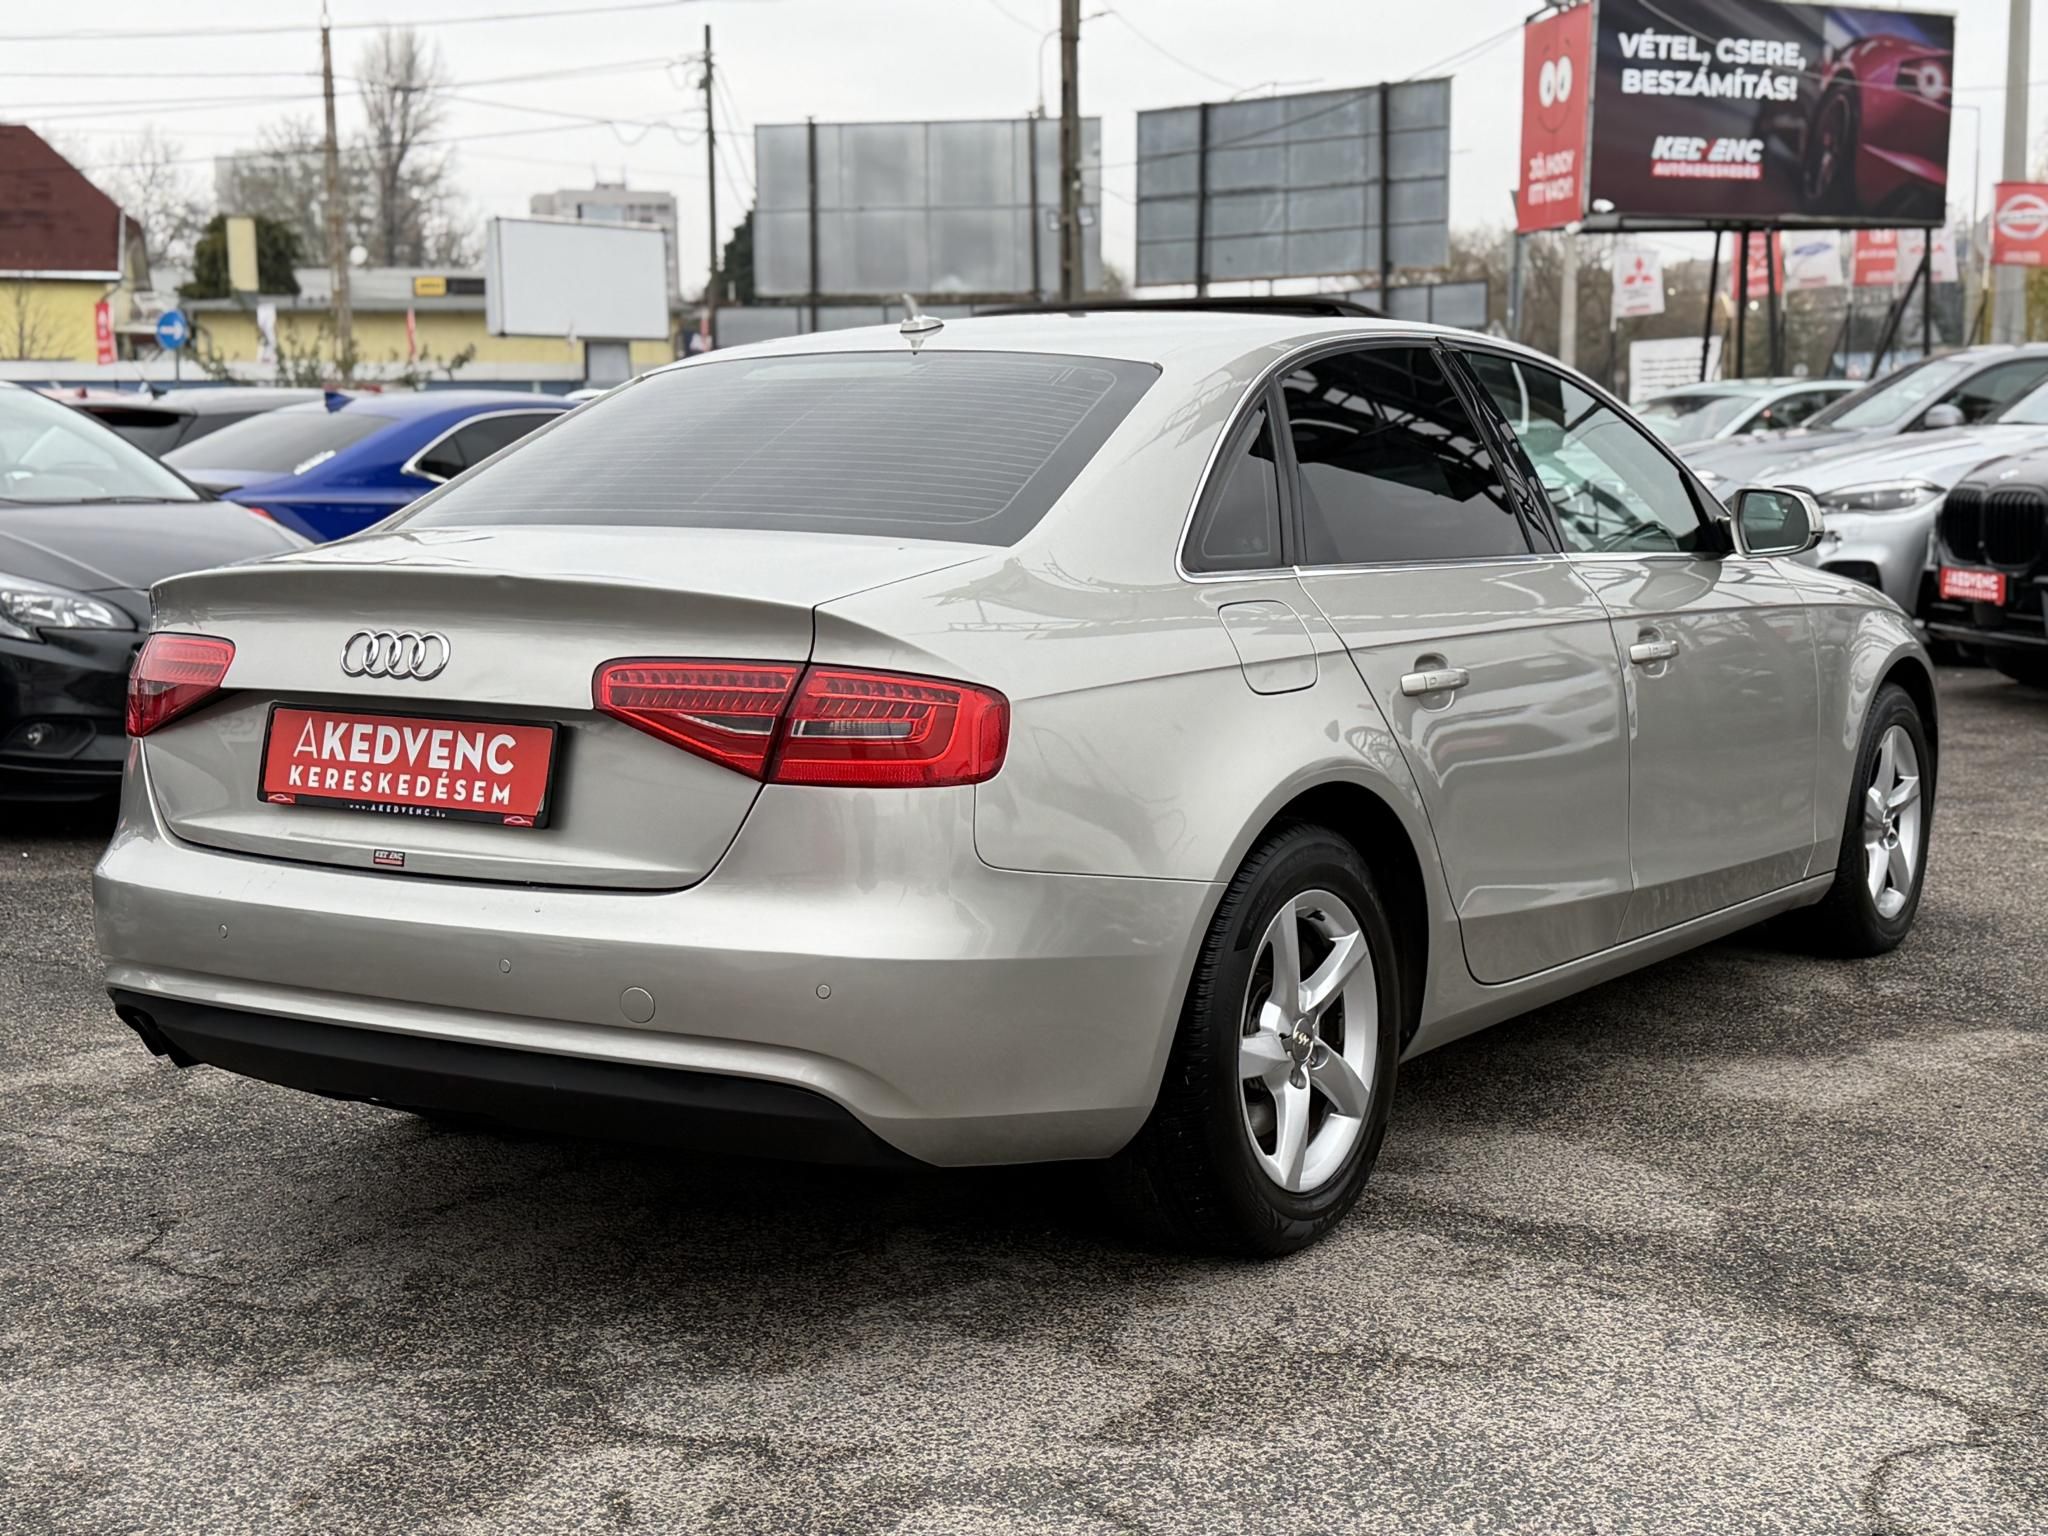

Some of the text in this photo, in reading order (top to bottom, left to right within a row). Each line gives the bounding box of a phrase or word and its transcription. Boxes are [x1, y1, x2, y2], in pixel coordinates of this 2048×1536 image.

[1618, 27, 1807, 70] VÉTEL, CSERE,
[1621, 66, 1798, 101] BESZÁMÍTÁS!
[293, 716, 516, 775] AKEDVENC
[289, 764, 511, 806] KERESKEDÉSEM
